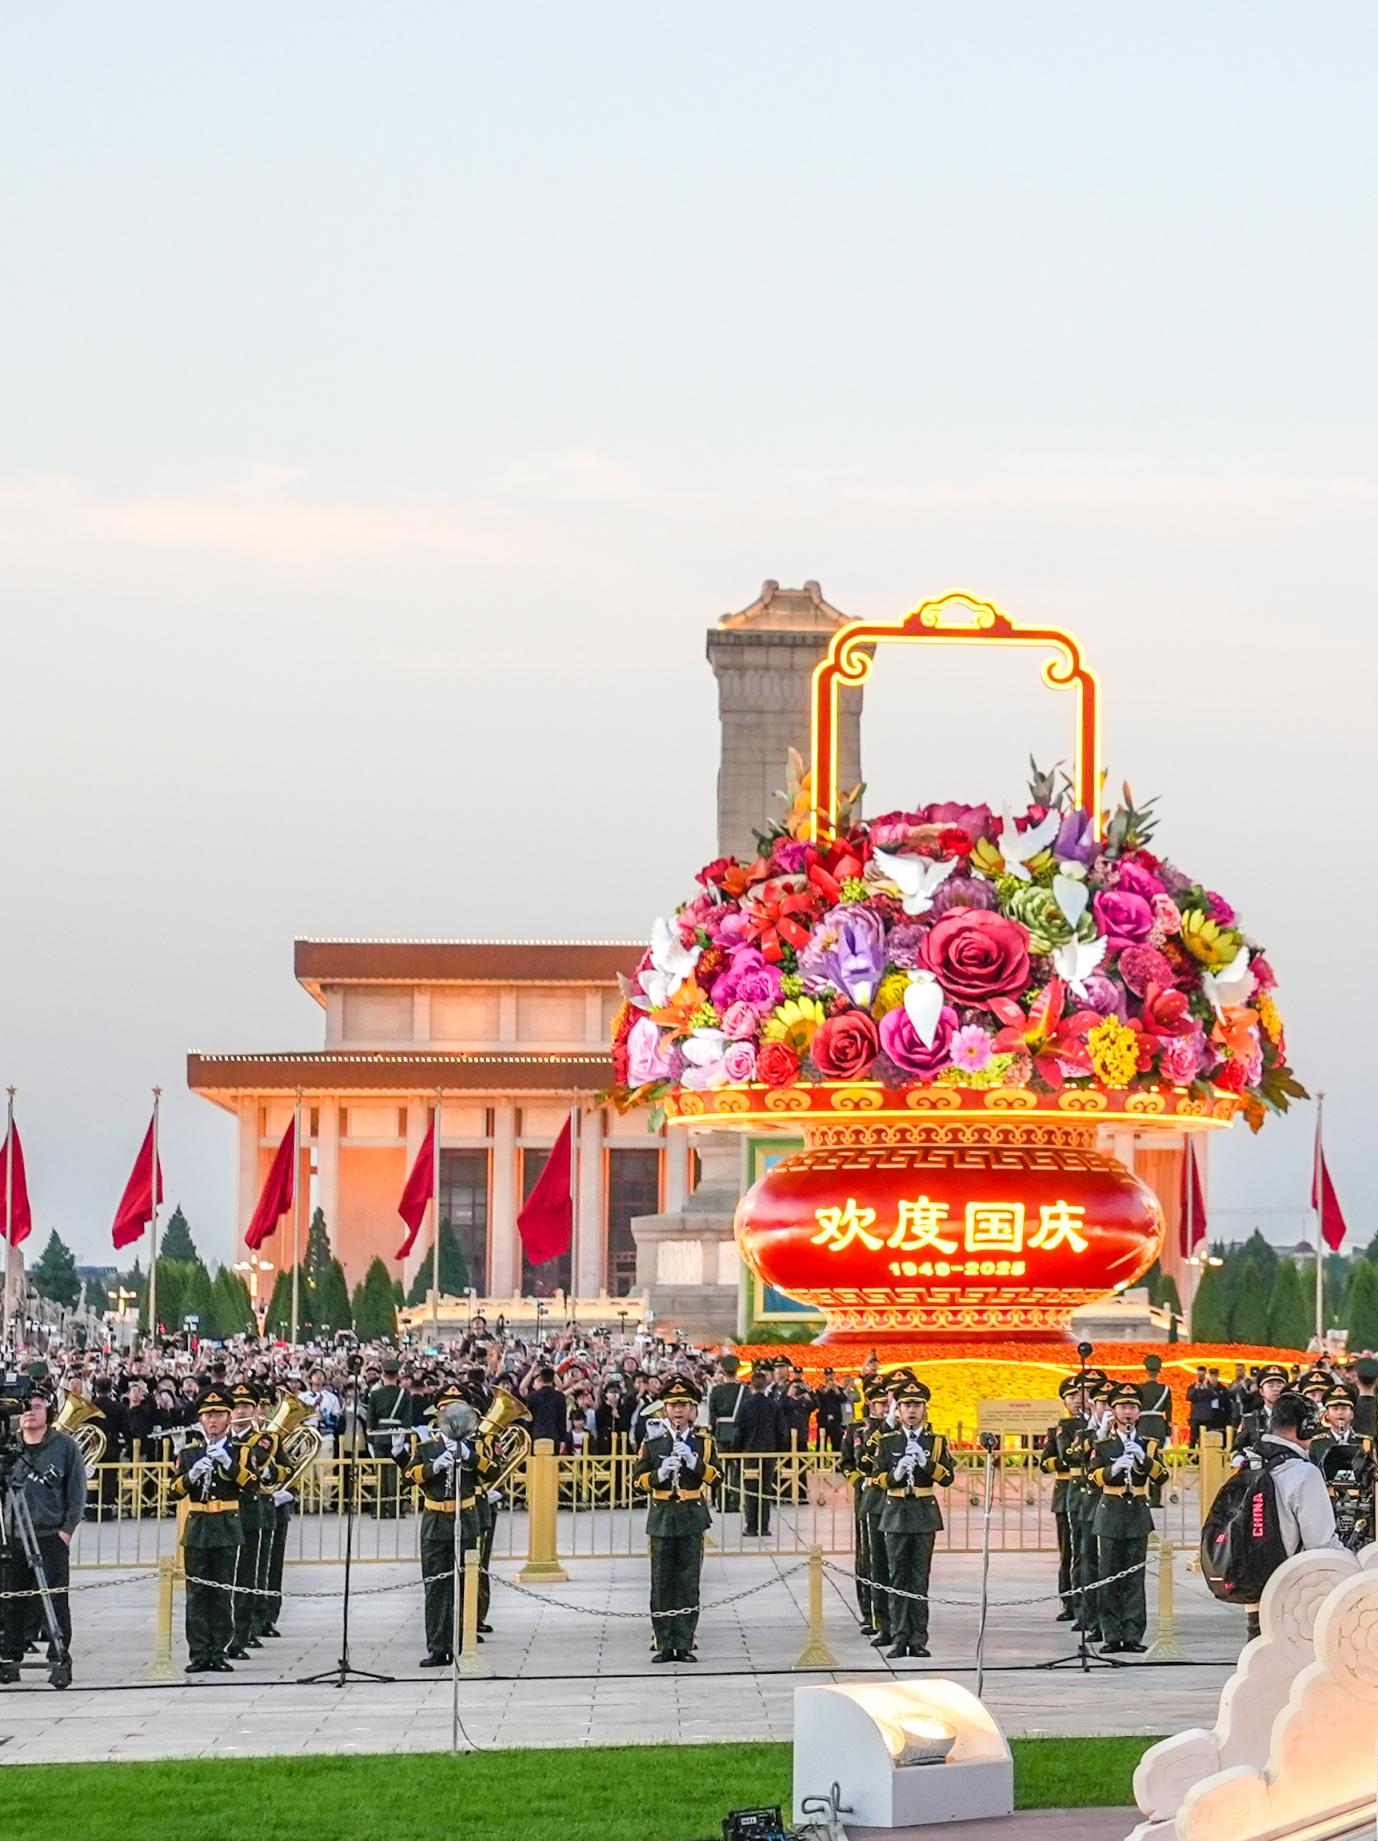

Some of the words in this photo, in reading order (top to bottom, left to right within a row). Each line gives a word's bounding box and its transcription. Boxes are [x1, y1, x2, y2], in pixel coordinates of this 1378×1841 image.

[810, 1195, 1089, 1255] 欢度国庆
[889, 1260, 1026, 1277] 1949-2025
[1252, 1491, 1264, 1538] CHINA
